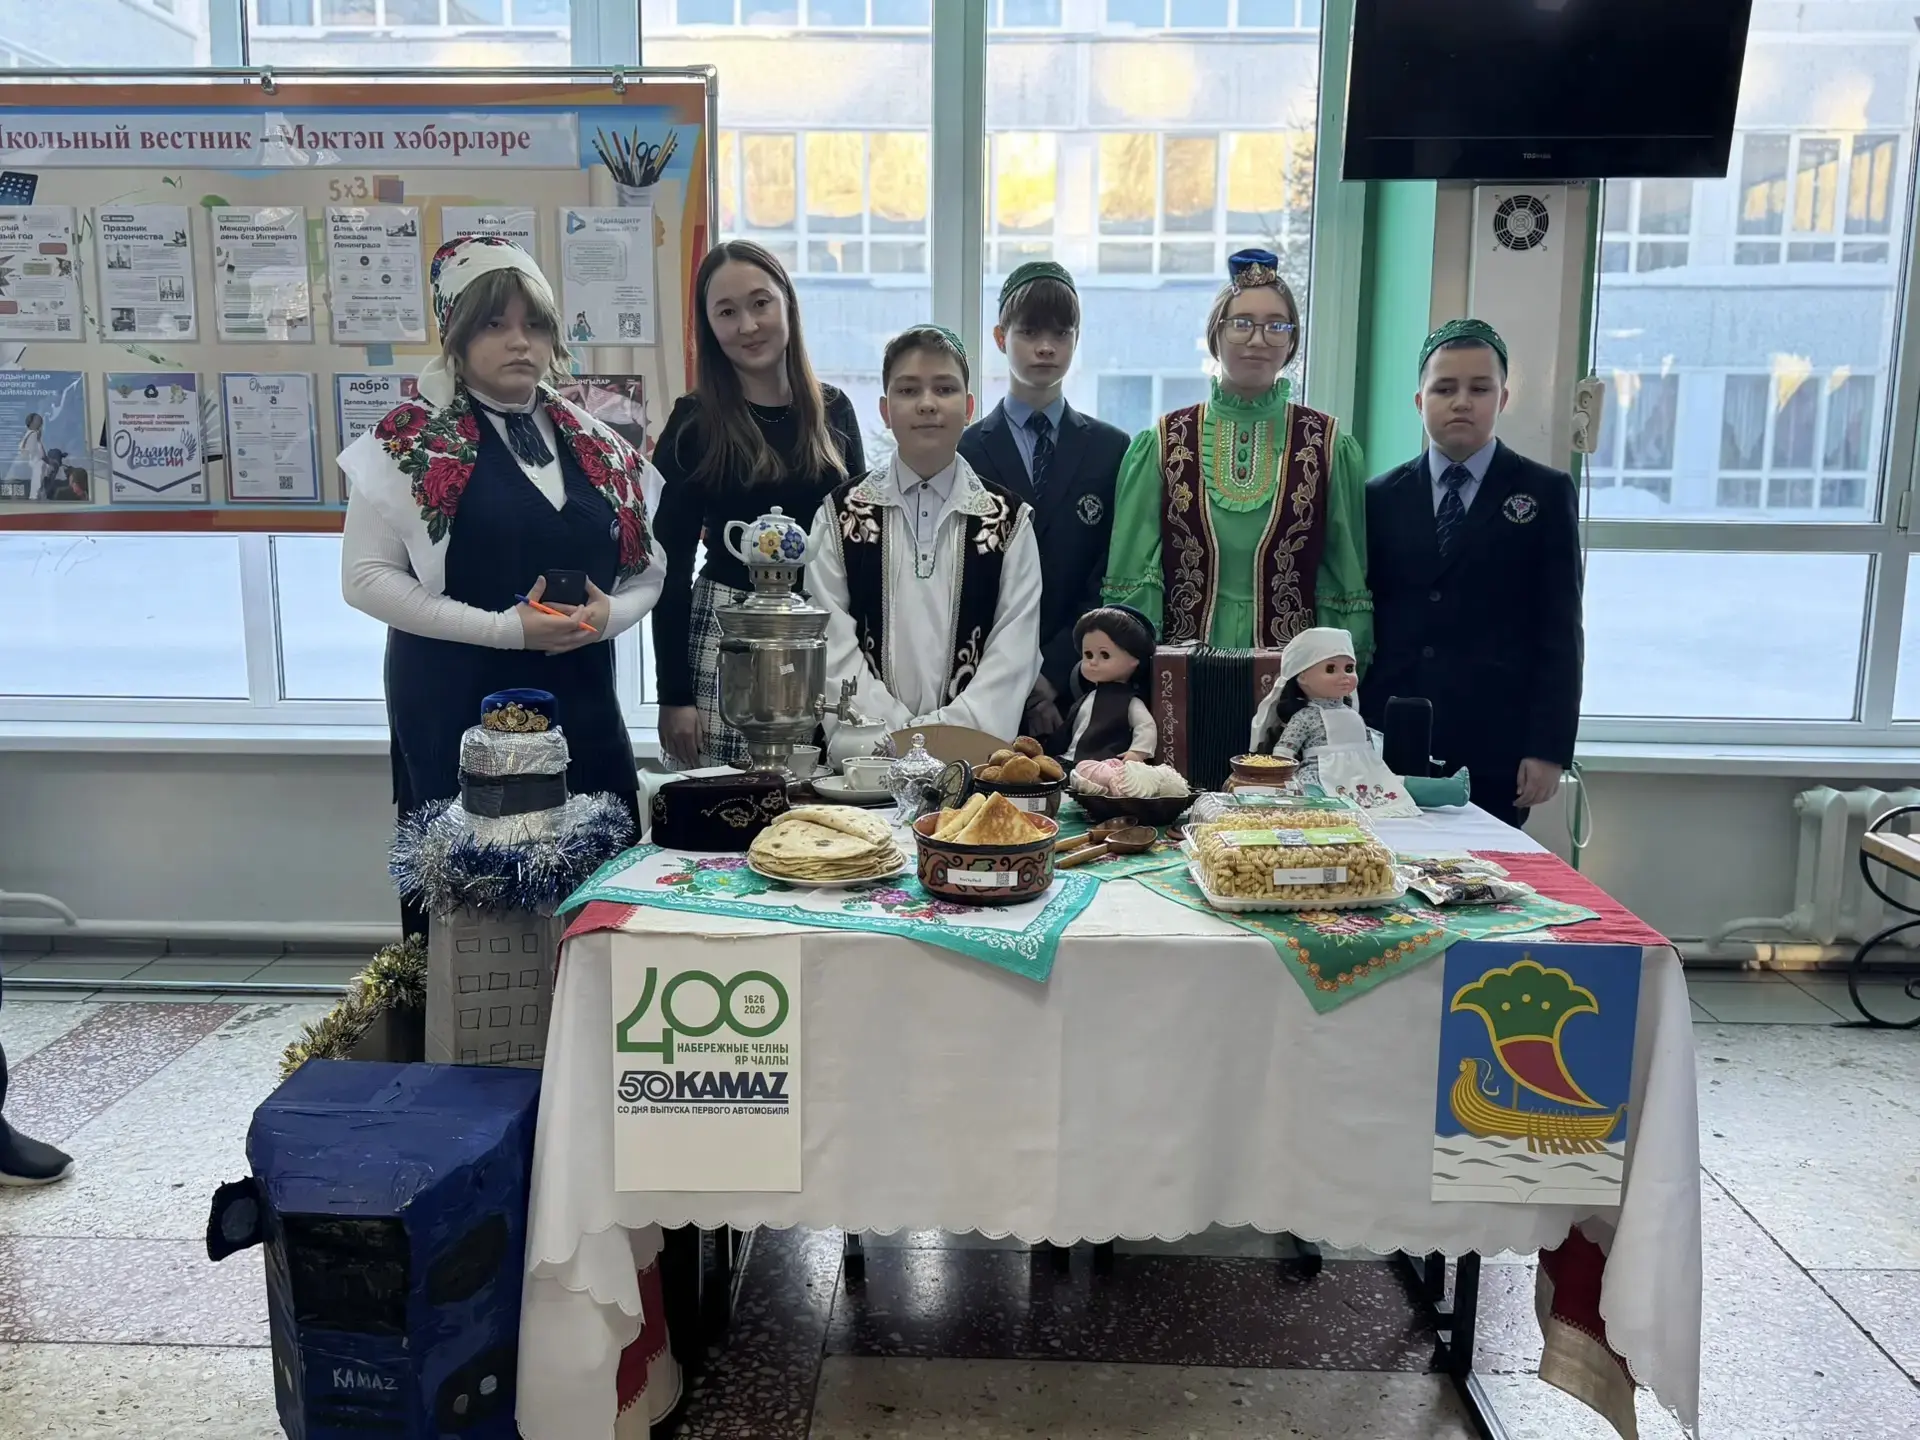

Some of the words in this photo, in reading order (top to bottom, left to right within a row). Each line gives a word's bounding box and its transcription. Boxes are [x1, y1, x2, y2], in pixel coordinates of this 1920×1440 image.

[140, 131, 252, 149] вестник
[280, 124, 384, 149] Мәктәп
[394, 124, 531, 156] хәбәрләре
[478, 217, 506, 225] Новый
[103, 224, 147, 233] Праздник
[219, 224, 286, 233] Международный
[103, 233, 164, 241] студенчества
[220, 233, 239, 241] день
[240, 233, 255, 241] без
[256, 233, 298, 241] Интернета
[349, 380, 390, 394] добро
[350, 422, 366, 430] Как
[113, 429, 183, 465] Орлята
[132, 457, 184, 468] РОССИИ
[743, 995, 766, 1004] 1626
[743, 1005, 766, 1015] 2026
[677, 1043, 749, 1053] НАБЕРЕЖНЫЕ
[751, 1043, 789, 1054] ЧЕЛНЫ
[734, 1055, 749, 1066] ЯР
[750, 1055, 789, 1066] ЧАЛЛЫ
[617, 1070, 675, 1103] 50
[675, 1071, 789, 1099] KAMAZ
[617, 1106, 630, 1114] СО
[631, 1106, 648, 1115] ДНЯ
[650, 1106, 690, 1114] ВЫПУСКА
[691, 1106, 730, 1115] ПЕРВОГО
[732, 1106, 789, 1115] АВТОМОБИЛЯ
[333, 1367, 399, 1391] KAMAZ
